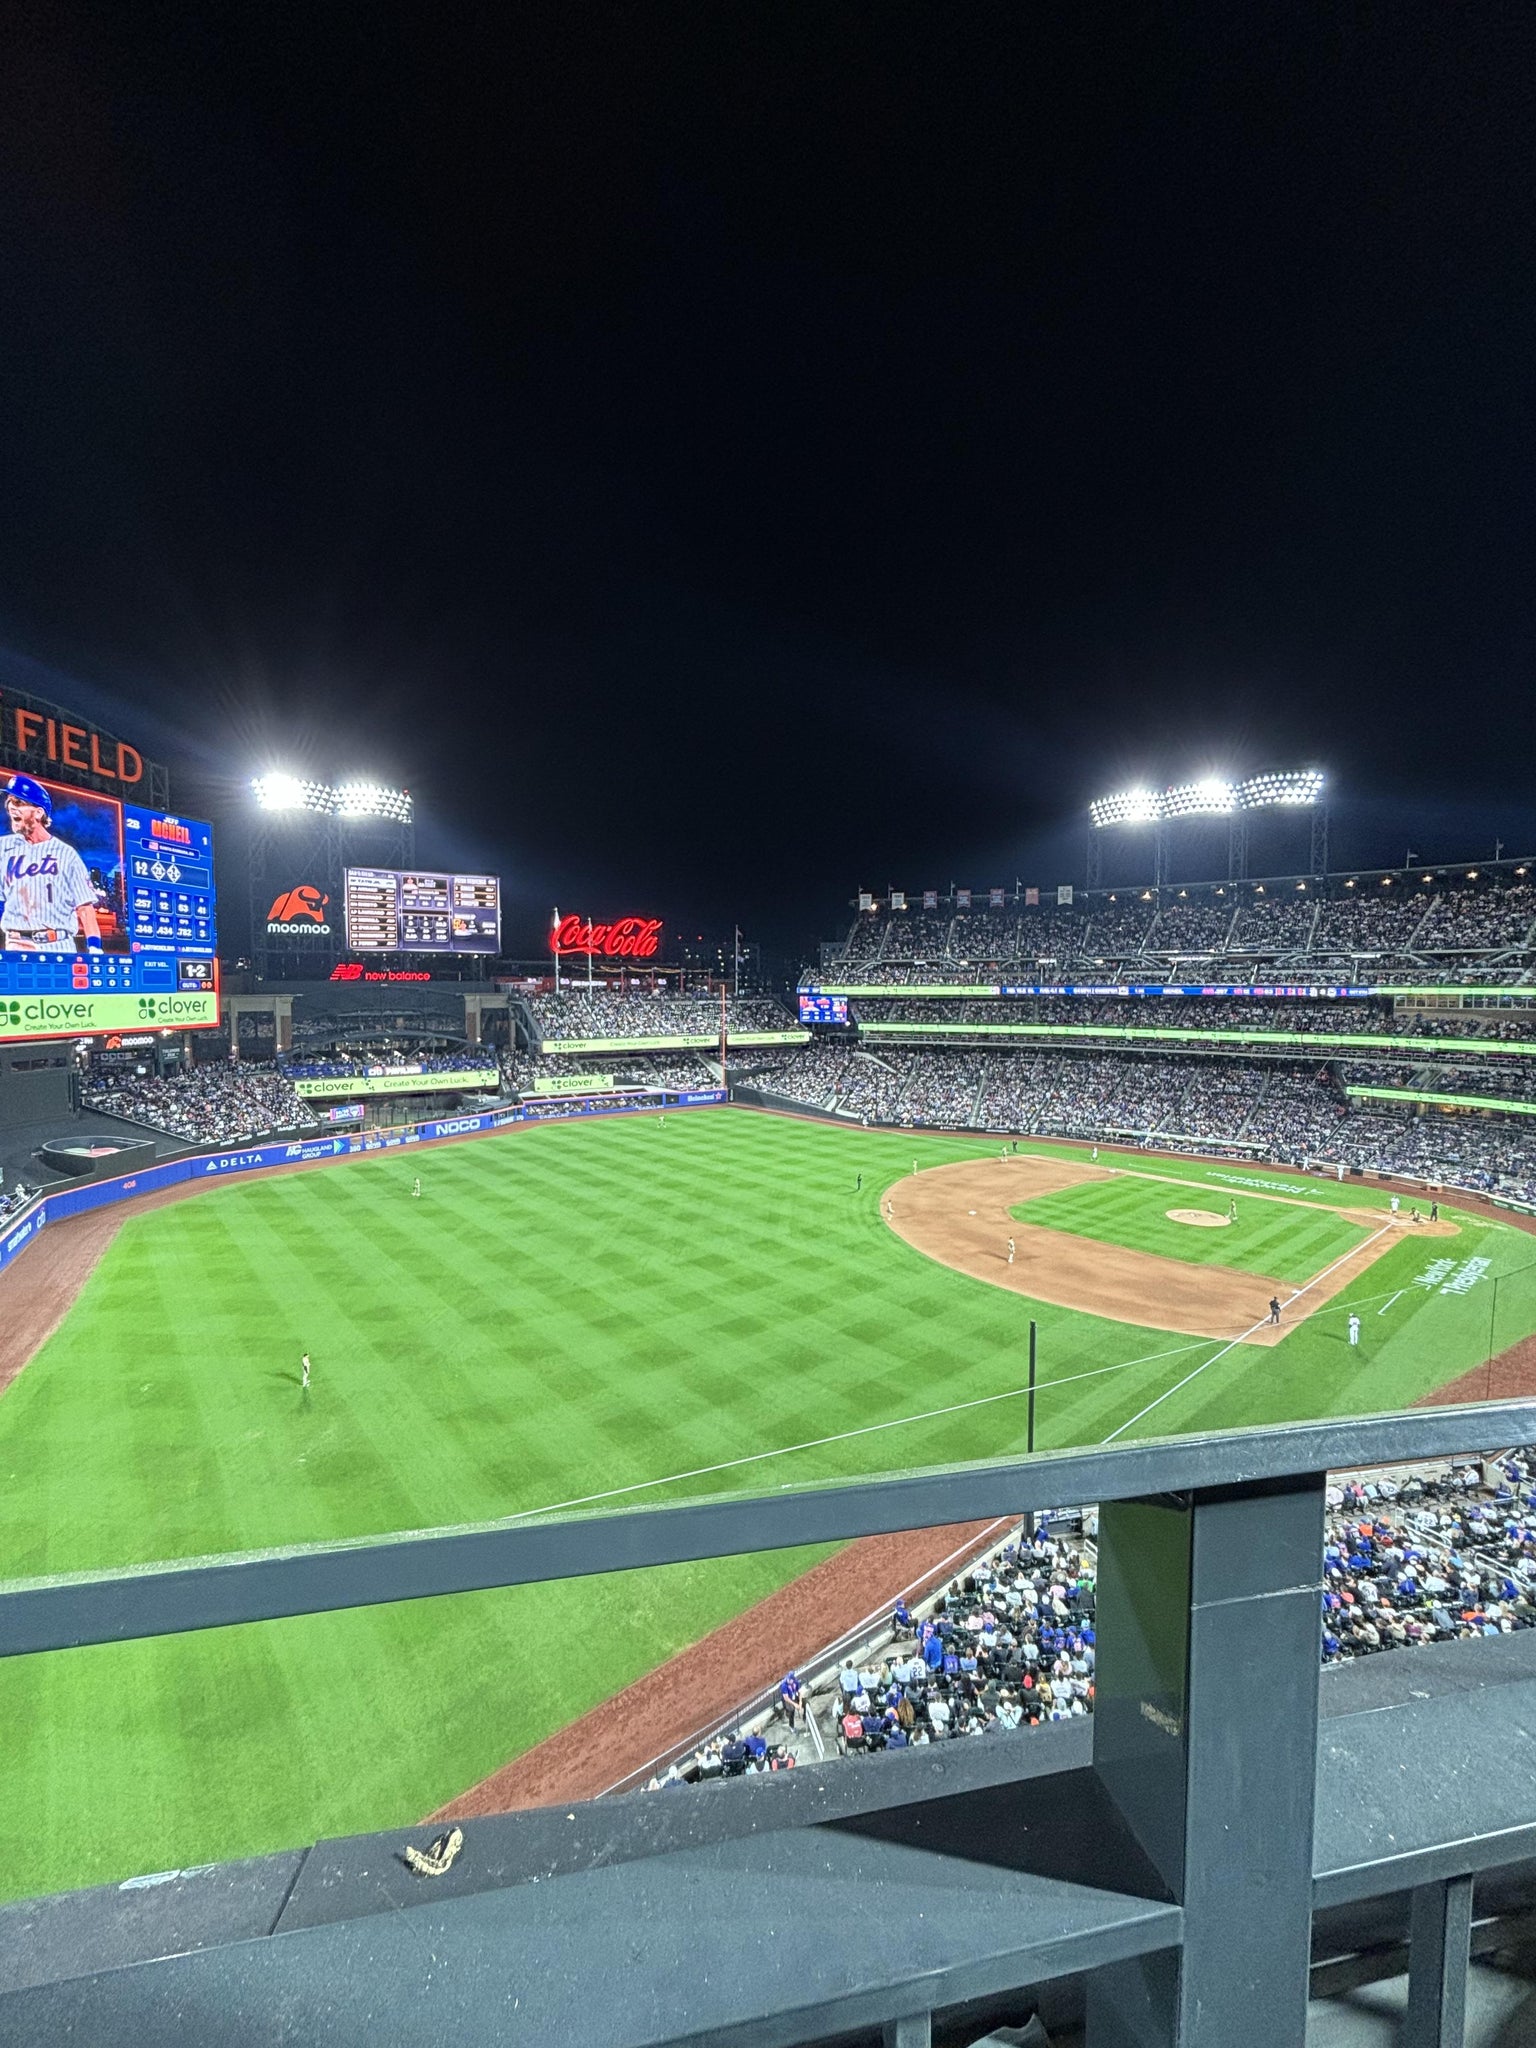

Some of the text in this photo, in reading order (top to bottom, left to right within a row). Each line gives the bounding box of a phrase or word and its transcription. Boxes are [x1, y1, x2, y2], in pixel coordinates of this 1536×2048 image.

[15, 708, 143, 783] FIELD
[126, 818, 140, 830] 2B
[151, 819, 191, 844] MCNEIL
[202, 836, 208, 846] 1
[6, 854, 59, 885] Mets
[46, 883, 53, 904] 1
[160, 902, 169, 911] 12
[267, 923, 331, 935] moomoo
[551, 914, 663, 957] Coca-Cola
[20, 954, 28, 962] 7
[93, 966, 100, 974] 3
[108, 966, 116, 974] 0
[186, 965, 206, 978] 1-2
[365, 972, 387, 981] new
[389, 971, 431, 981] balance
[92, 979, 102, 987] 10
[109, 979, 116, 987] 0
[123, 979, 130, 987] 3
[25, 998, 94, 1020] clover
[158, 996, 207, 1014] clover
[122, 1036, 154, 1046] moomoo
[314, 1082, 354, 1093] clover
[384, 1080, 410, 1088] Create
[562, 1078, 593, 1088] clover
[436, 1118, 480, 1135] NOCO
[302, 1144, 333, 1153] HAUGLAND
[220, 1154, 263, 1168] DELTA
[302, 1151, 322, 1160] GROUP
[912, 1666, 922, 1677] 22
